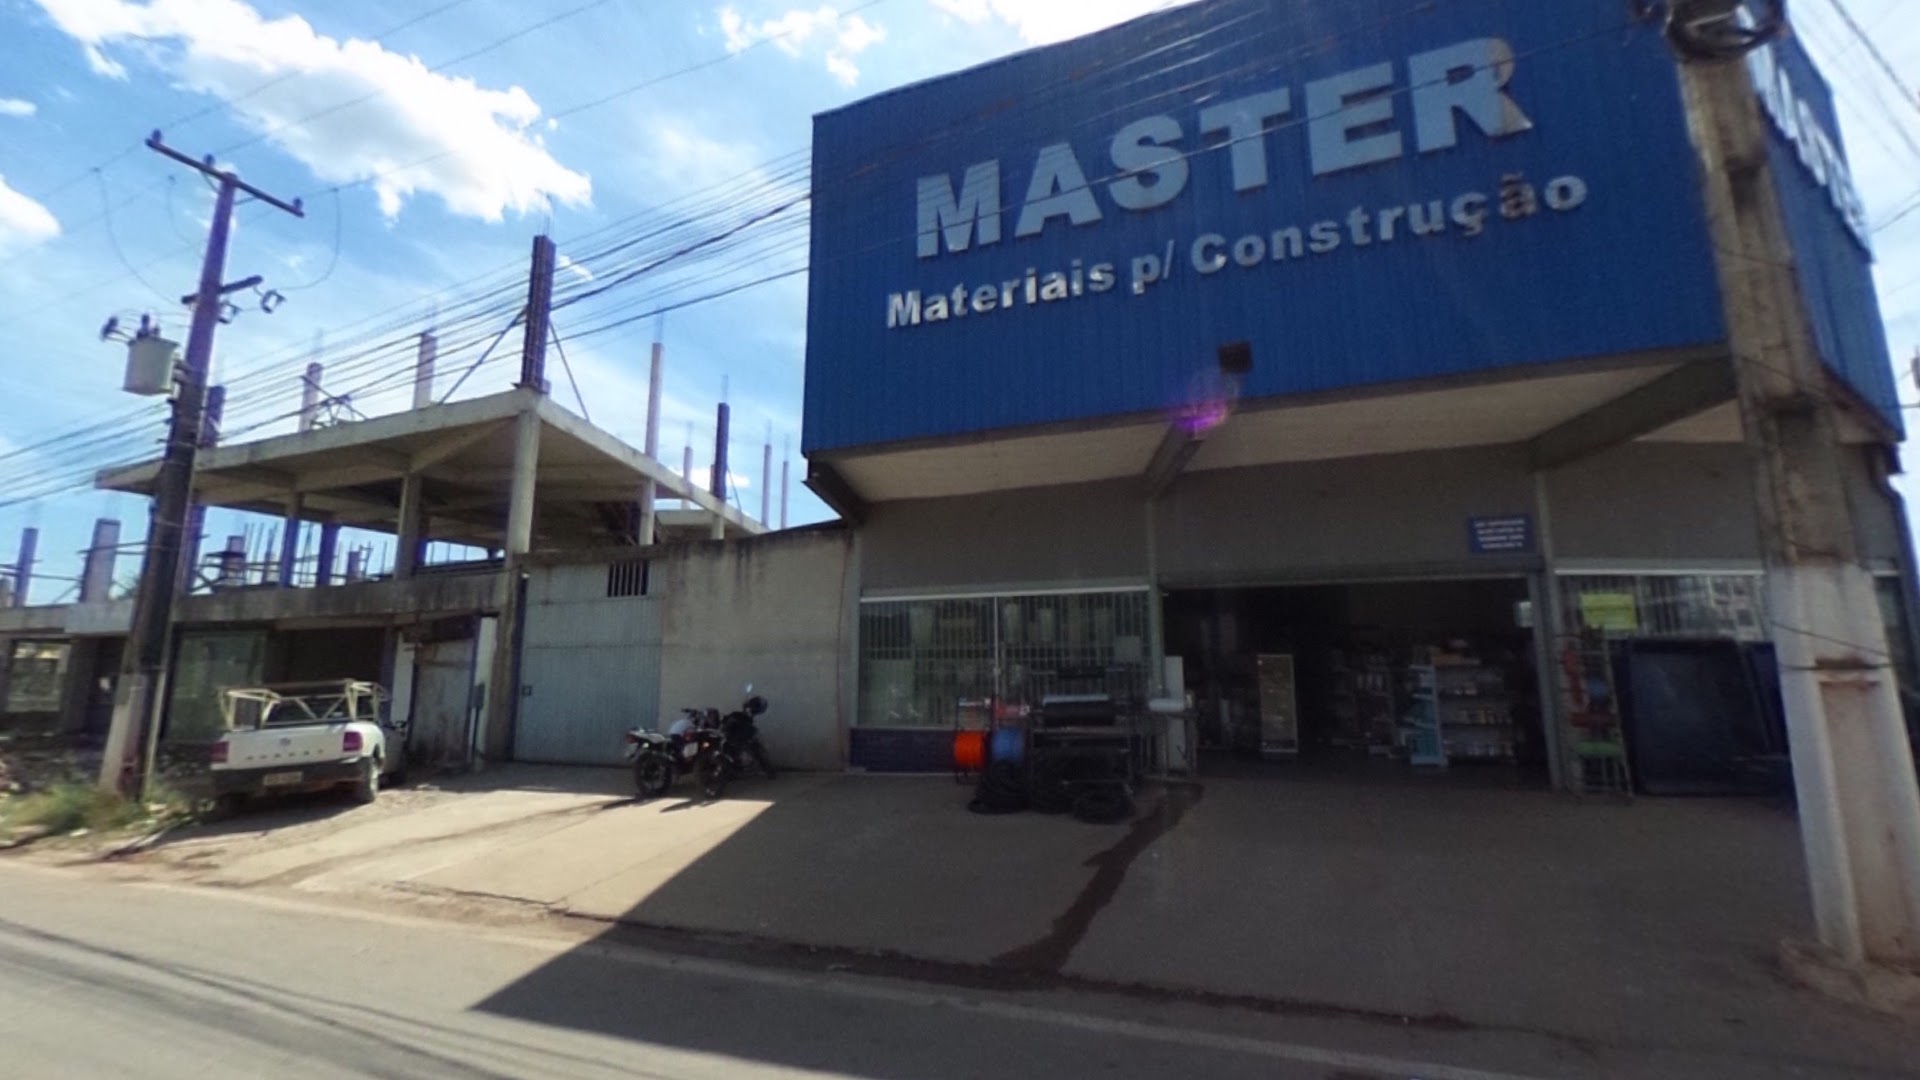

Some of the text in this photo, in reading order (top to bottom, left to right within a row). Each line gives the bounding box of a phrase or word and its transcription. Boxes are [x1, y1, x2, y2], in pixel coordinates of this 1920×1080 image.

[916, 37, 1532, 258] MASTER
[887, 173, 1588, 328] Materiais p/ Construção
